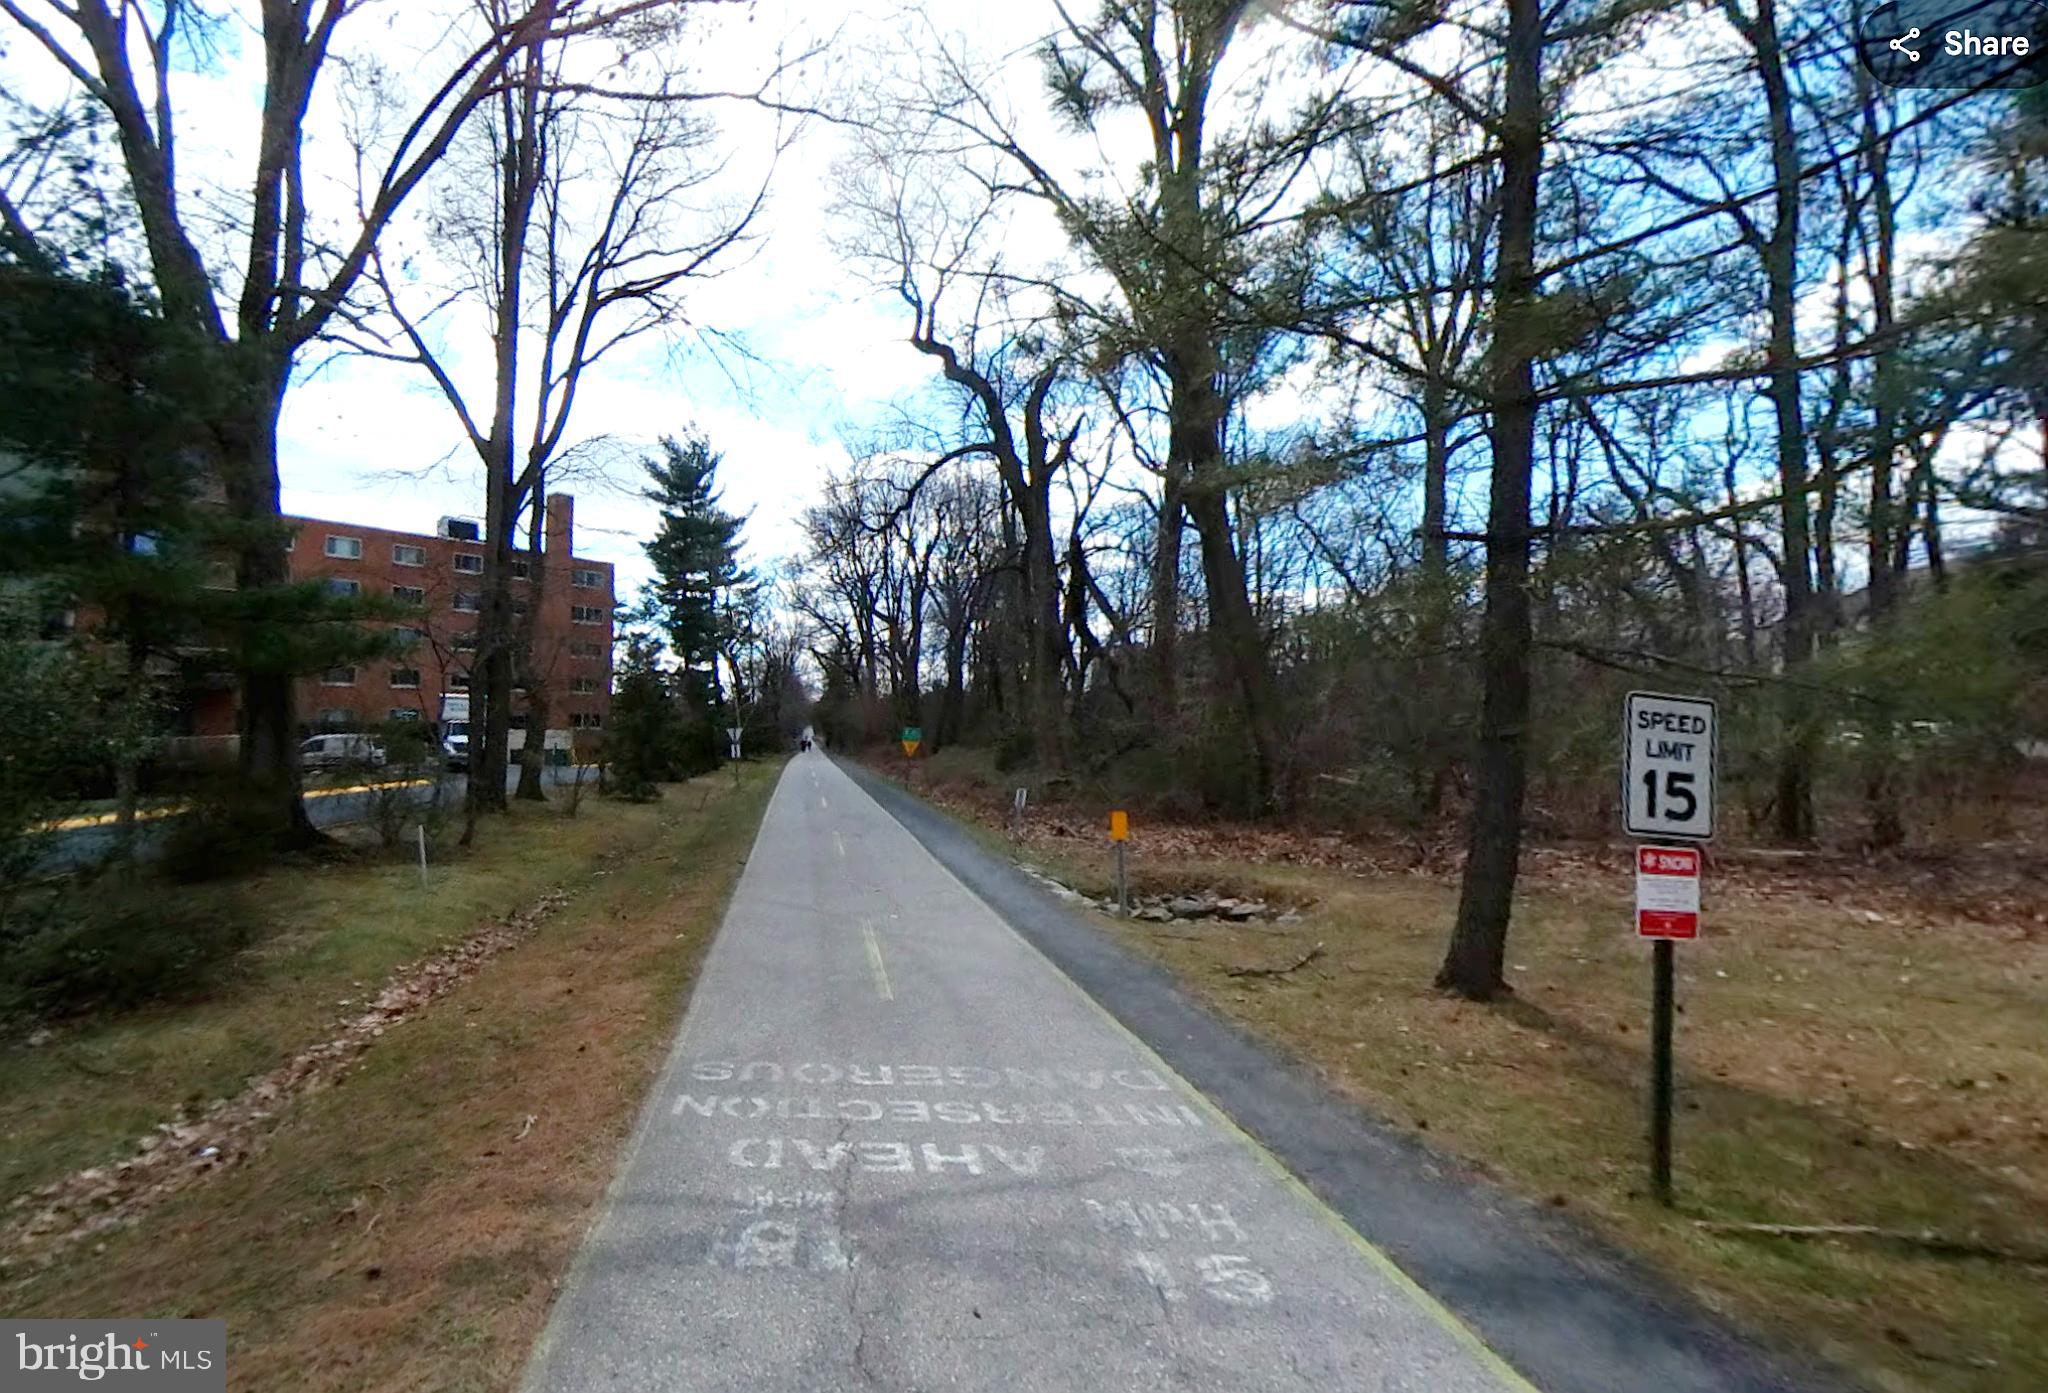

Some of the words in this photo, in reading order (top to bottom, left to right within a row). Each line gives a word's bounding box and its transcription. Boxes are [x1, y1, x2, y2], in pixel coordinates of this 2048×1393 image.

[1638, 710, 1706, 734] SPEED
[1646, 738, 1695, 762] LIMIT
[1643, 769, 1697, 821] 15
[691, 1061, 1173, 1091] DANGEROUS
[671, 1094, 1201, 1126] INTERSECTION
[729, 1137, 1045, 1176] AHEAD
